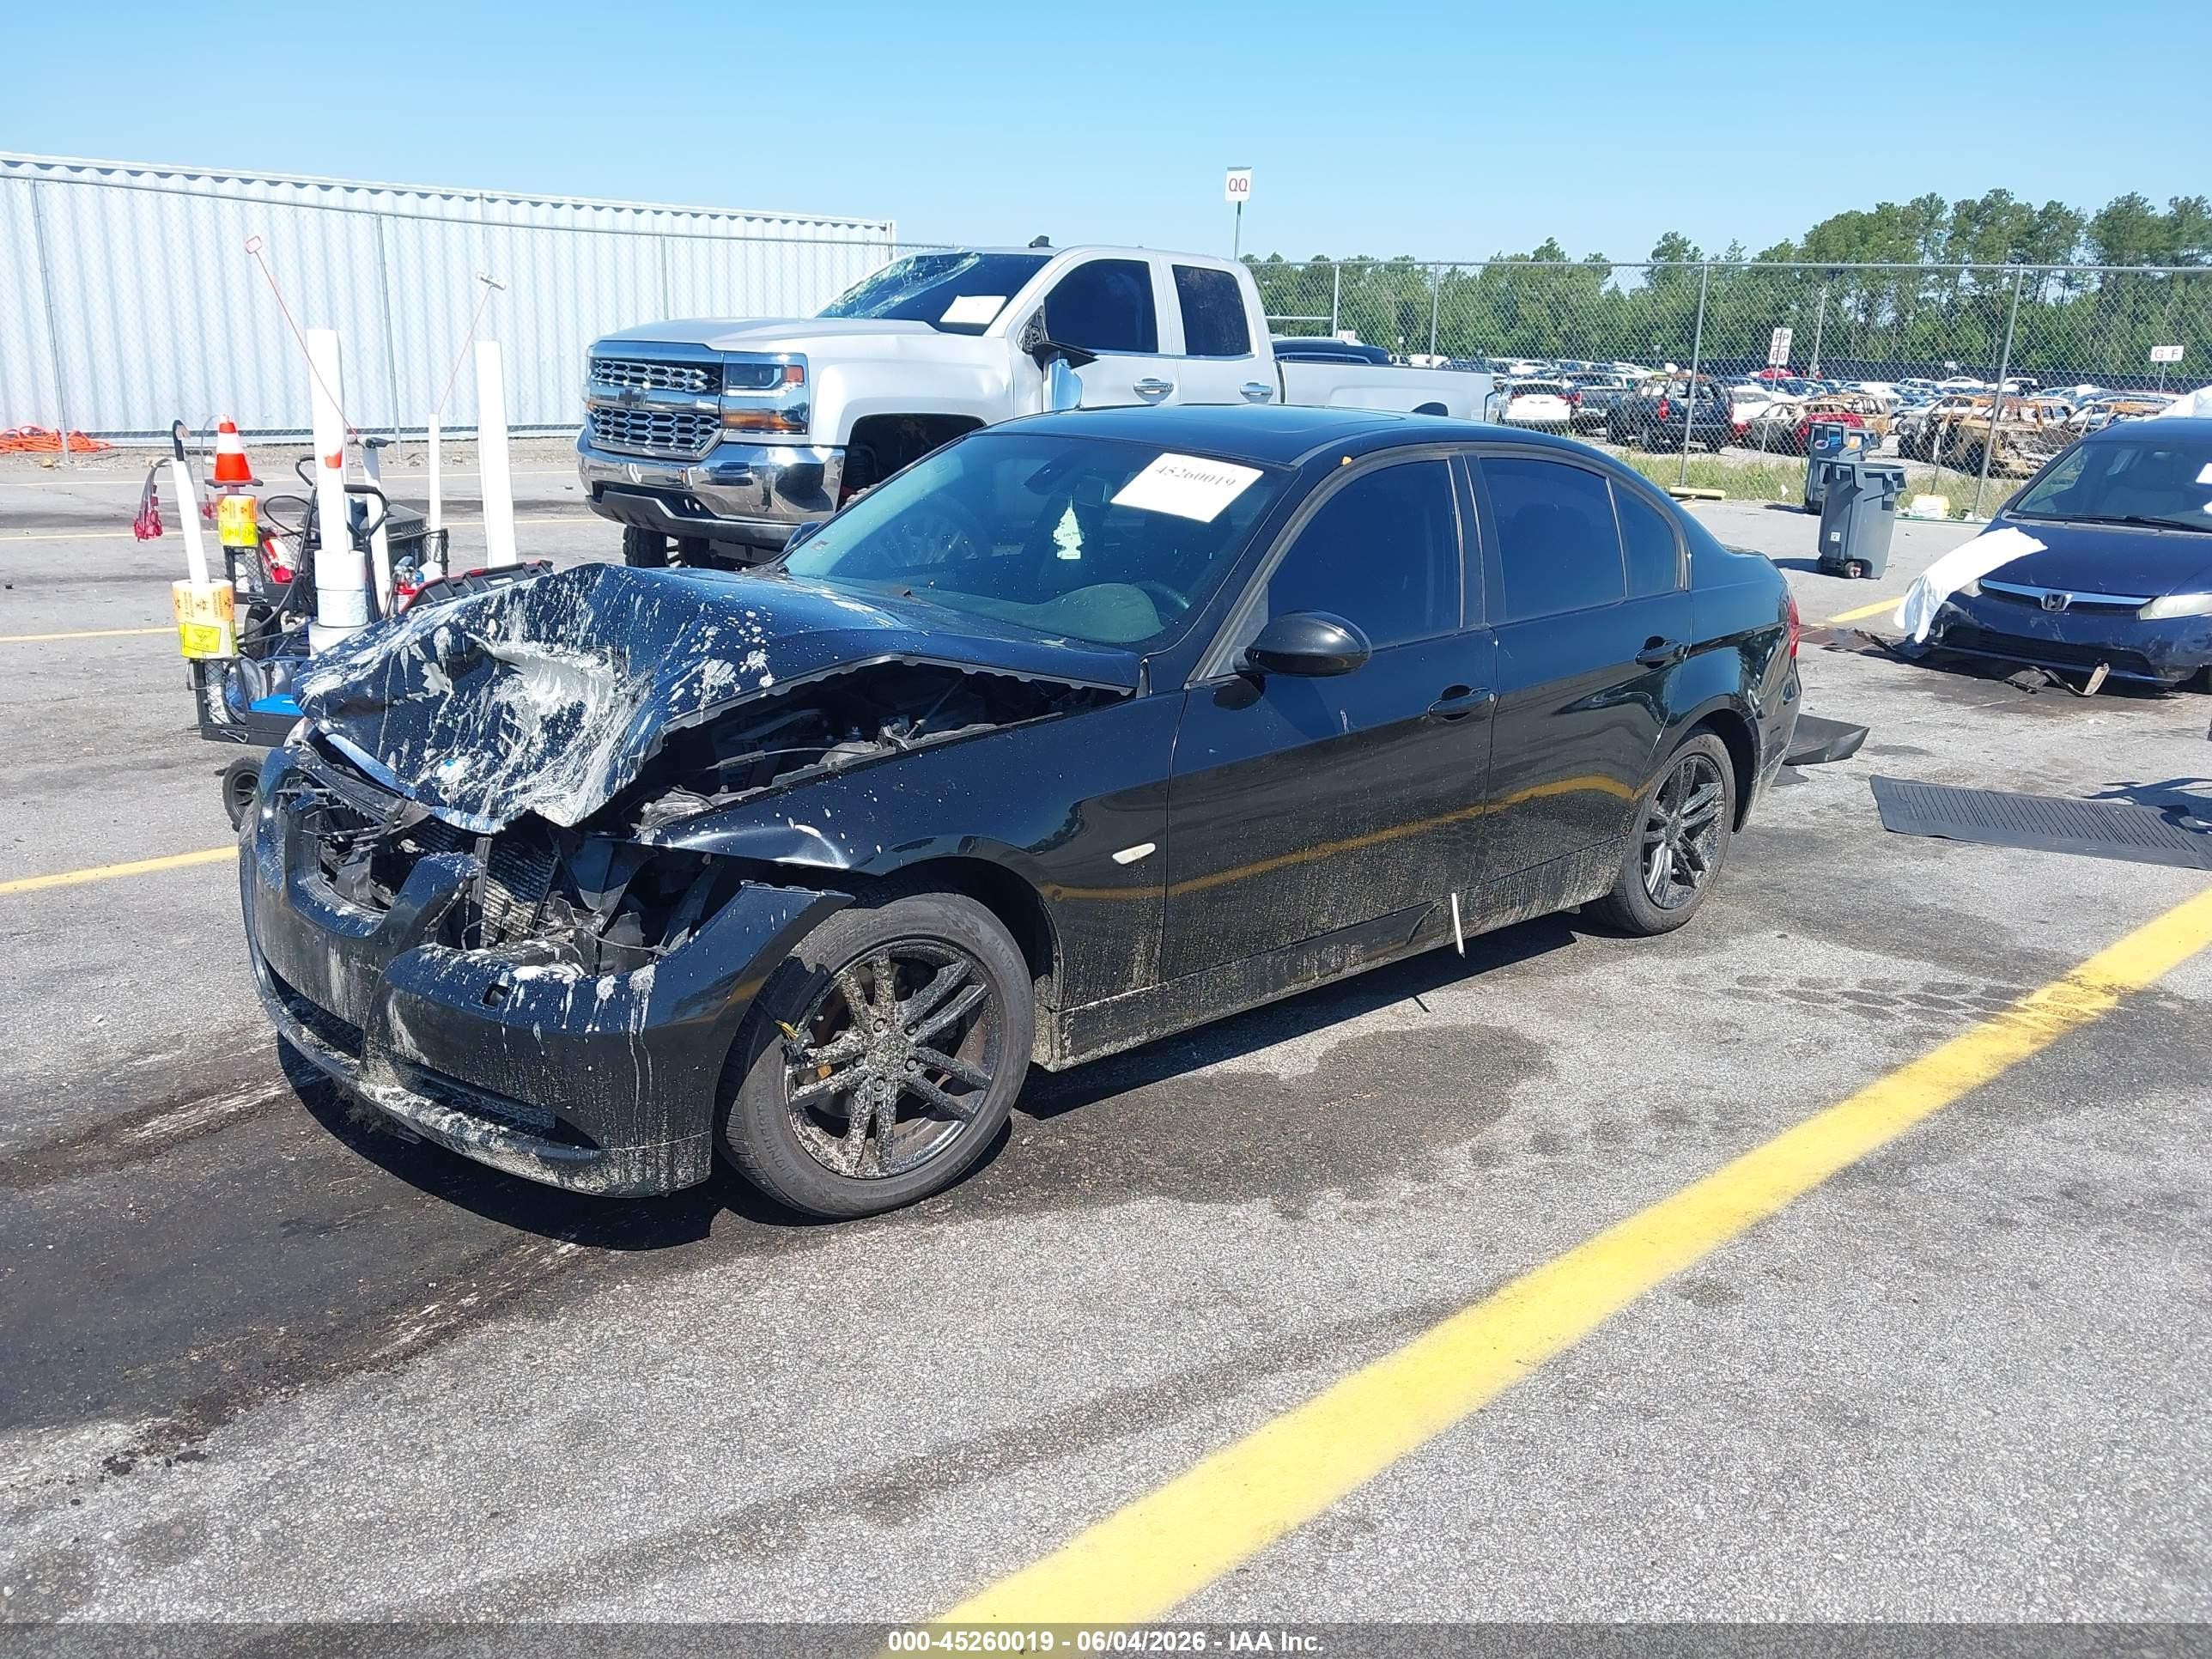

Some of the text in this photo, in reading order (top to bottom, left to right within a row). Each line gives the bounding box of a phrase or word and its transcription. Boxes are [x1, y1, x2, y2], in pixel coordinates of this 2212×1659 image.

[1229, 178, 1248, 191] QQ
[2154, 349, 2179, 359] G F
[1155, 465, 1237, 487] 45260019
